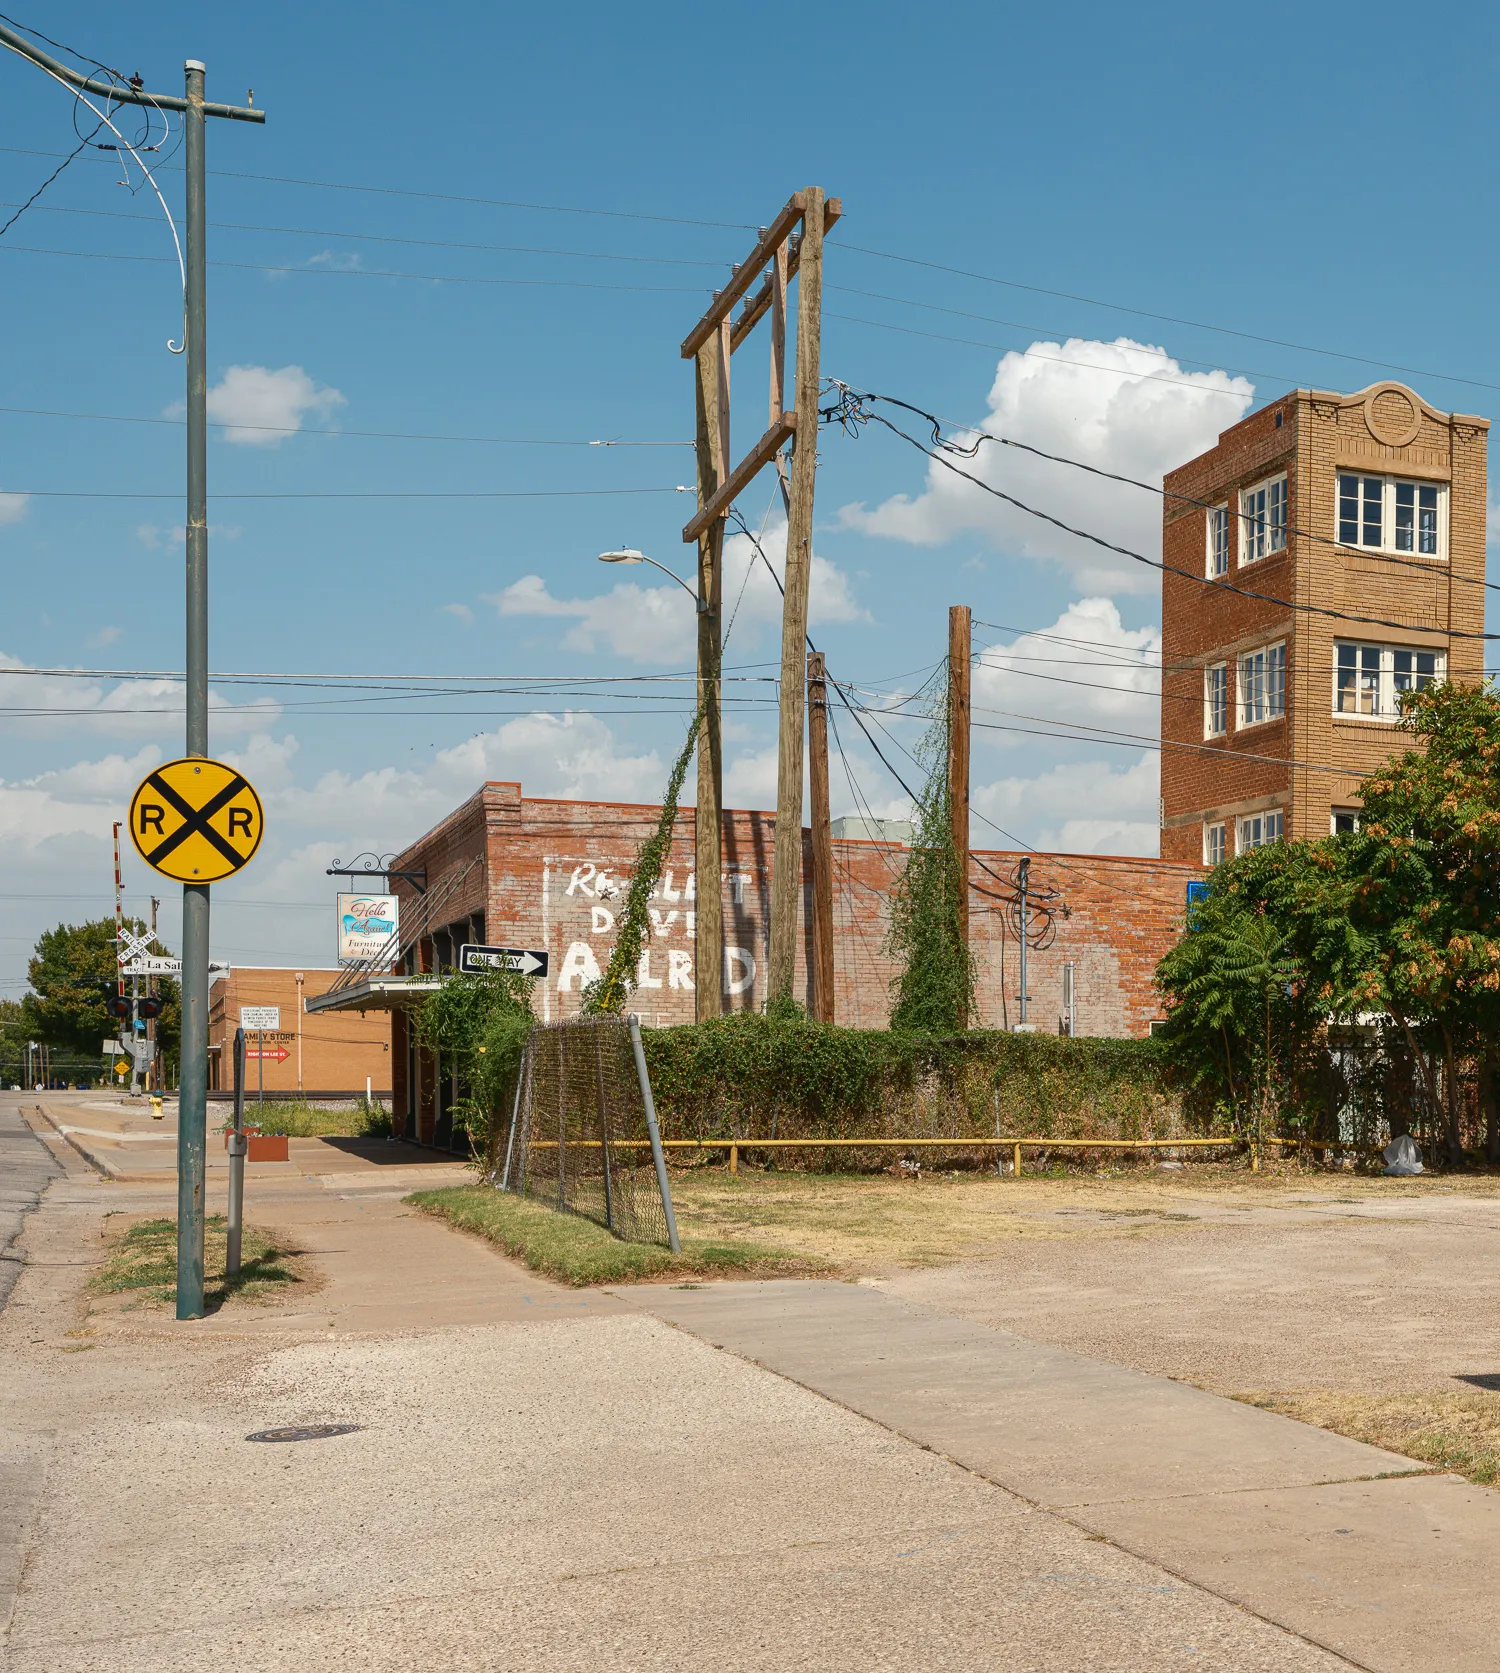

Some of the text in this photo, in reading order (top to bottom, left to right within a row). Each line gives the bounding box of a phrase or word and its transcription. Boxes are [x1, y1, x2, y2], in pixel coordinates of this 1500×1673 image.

[140, 804, 253, 838] R R
[350, 902, 389, 917] Hello
[592, 906, 697, 938] DVE
[118, 930, 156, 961] CROSSING
[119, 929, 136, 948] RAIL
[147, 960, 161, 969] La
[557, 942, 756, 995] ALRD
[270, 1033, 296, 1041] STORE
